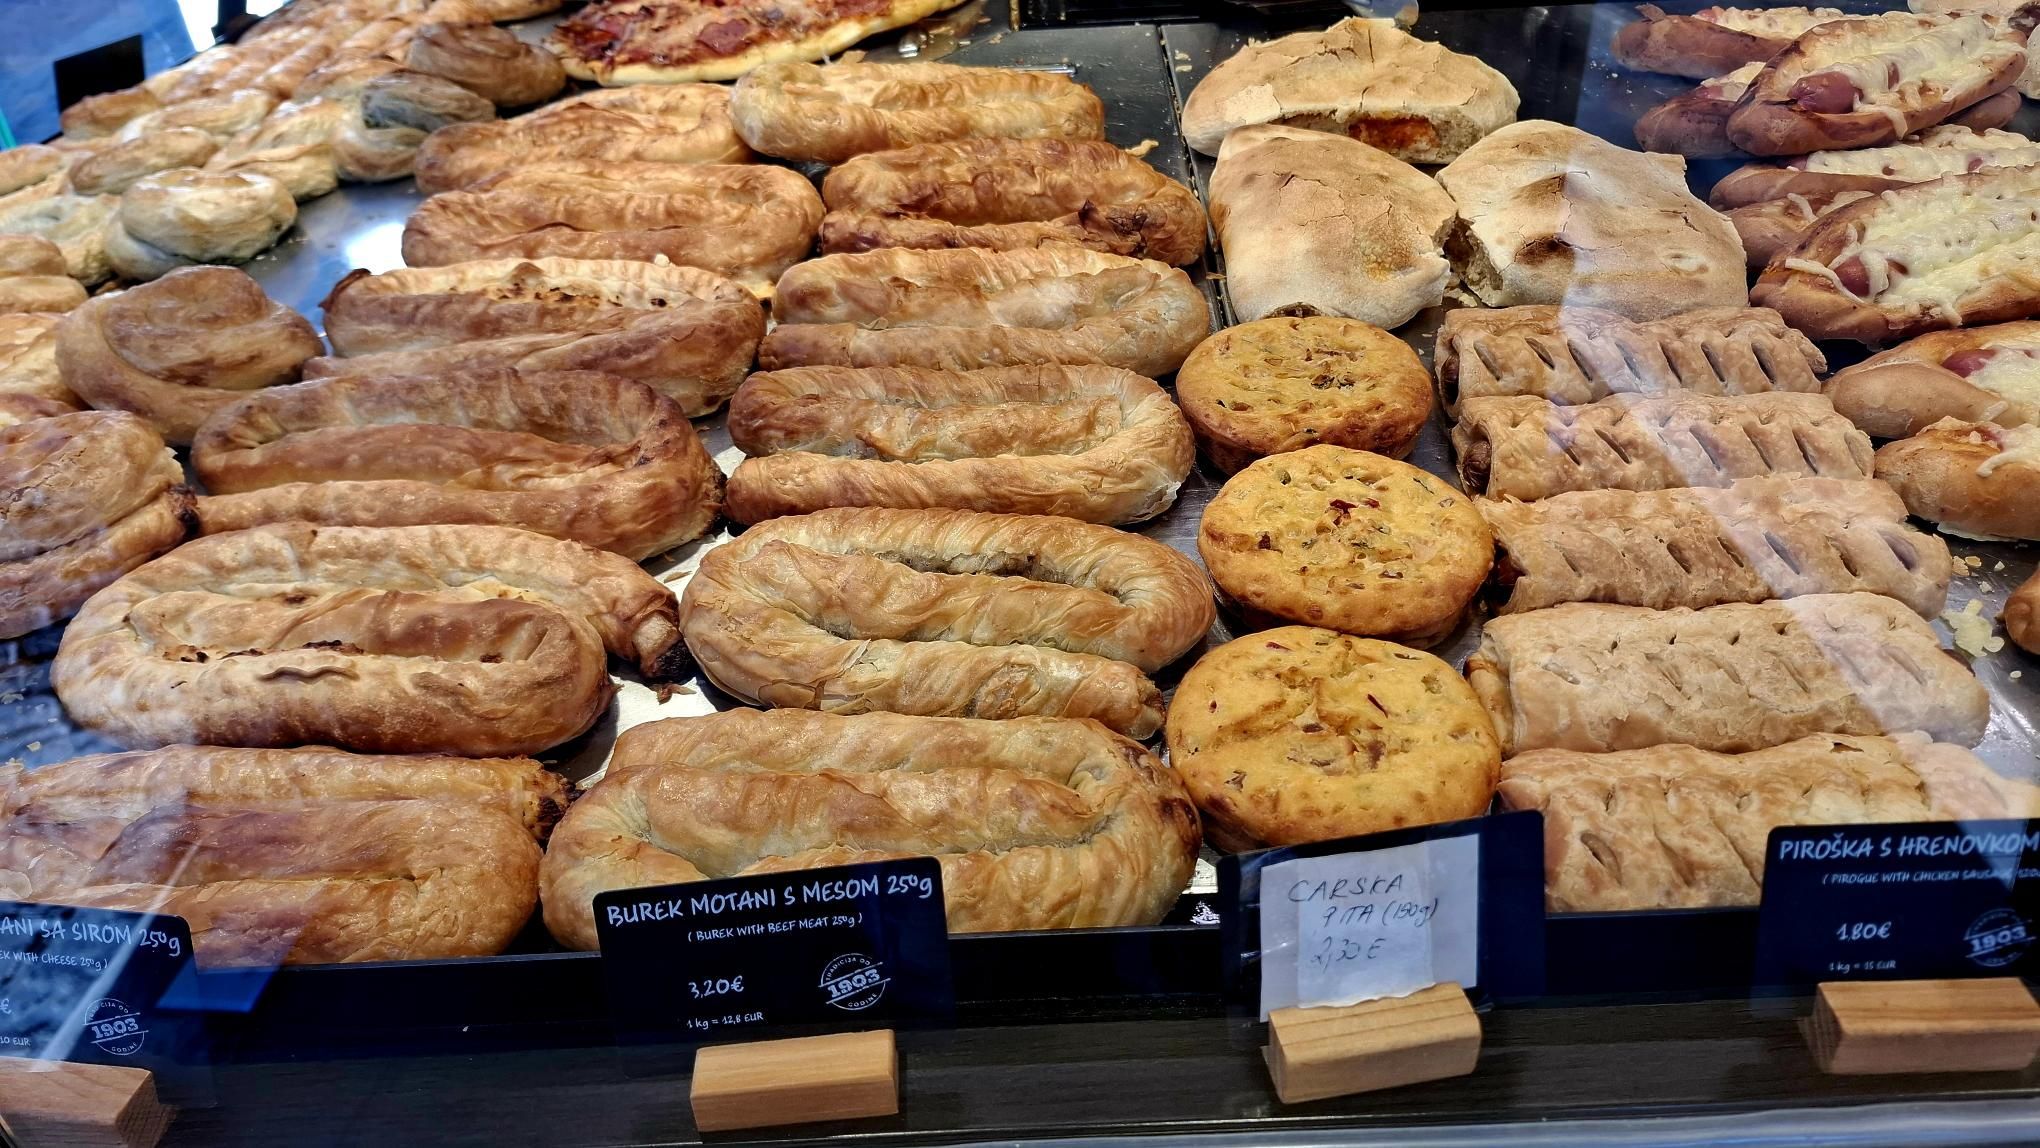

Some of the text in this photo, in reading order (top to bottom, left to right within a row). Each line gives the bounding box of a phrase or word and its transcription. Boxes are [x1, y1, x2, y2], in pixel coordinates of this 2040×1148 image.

[1780, 831, 2040, 859] PIROŠKA S HRENOVKOM
[1288, 874, 1403, 902] CARSKA
[1831, 872, 1880, 884] PIROGUE
[1882, 871, 1910, 882] WITH
[1913, 870, 1960, 882] CHICKEN
[606, 874, 933, 927] BUREK MOTANI S MESOM 250g
[696, 927, 735, 942] BUREK
[736, 922, 766, 937] WITH
[768, 919, 797, 934] BEEF
[799, 915, 829, 930] MEAT
[832, 914, 855, 928] 250g
[1322, 903, 1374, 928] PITA
[40, 919, 66, 939] SA
[71, 922, 132, 945] SIROM
[139, 929, 181, 957] 250g
[1971, 926, 2027, 952] 1903
[12, 951, 39, 963] WITH
[41, 953, 78, 966] CHEESE
[80, 956, 102, 972] 250g
[1837, 961, 1851, 975] kg
[688, 975, 745, 999] 3,20€
[827, 968, 880, 998] 1903
[91, 1017, 139, 1039] 1903
[695, 1017, 709, 1030] kg
[721, 1014, 742, 1025] 12,8
[744, 1011, 764, 1022] EUR
[12, 1037, 31, 1046] EUR
